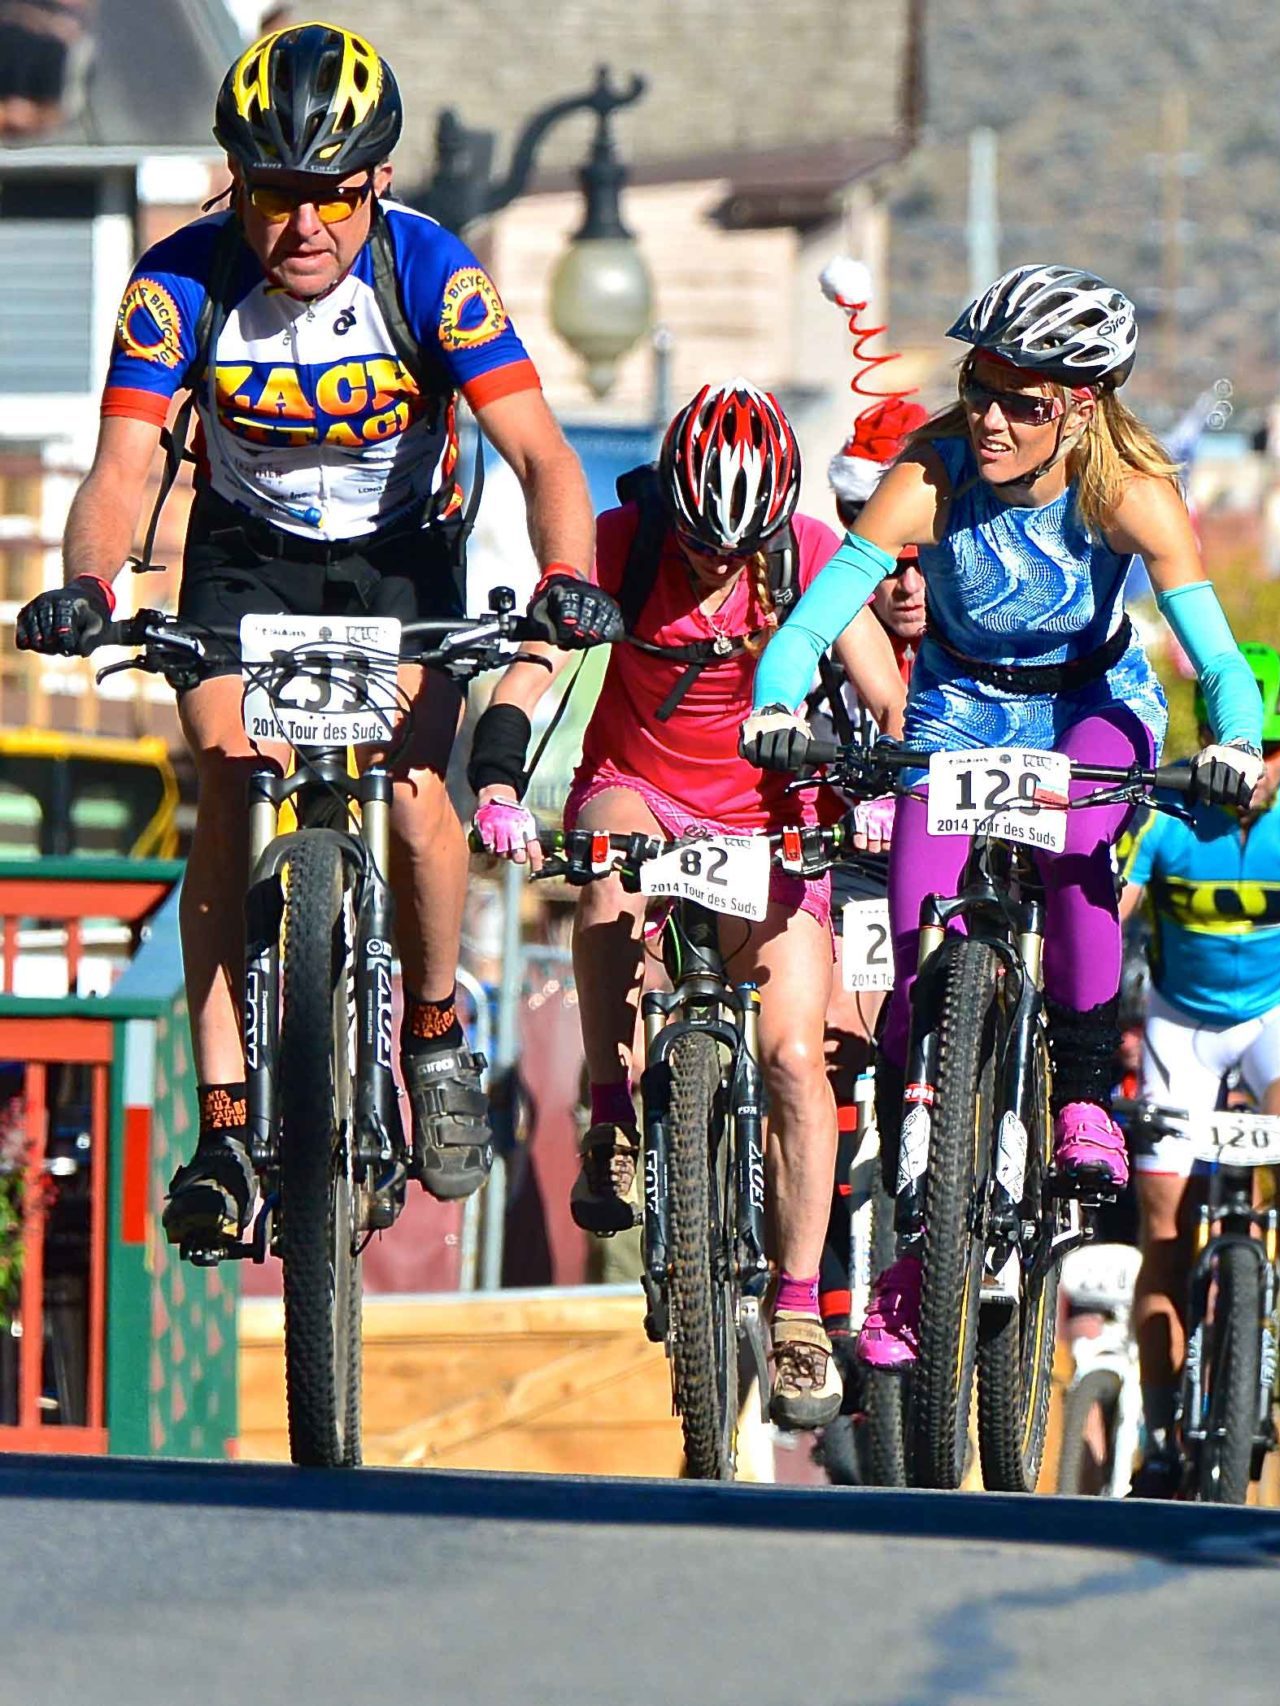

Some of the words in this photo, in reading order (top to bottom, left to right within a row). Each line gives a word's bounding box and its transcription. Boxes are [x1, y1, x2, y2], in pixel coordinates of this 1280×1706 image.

[1097, 315, 1127, 337] Giro
[253, 717, 285, 738] 2014
[288, 720, 319, 740] Tour
[323, 721, 348, 741] des
[351, 721, 384, 741] Suds
[937, 818, 969, 832] 2014
[972, 818, 1000, 833] Tour
[1003, 825, 1025, 839] des
[1028, 827, 1057, 848] Suds
[680, 846, 729, 887] 82
[650, 882, 680, 893] 2014
[683, 882, 706, 900] Tour
[707, 892, 728, 908] des
[730, 897, 758, 916] Suds
[866, 923, 888, 965] 2
[851, 973, 878, 987] 2014
[1210, 1126, 1270, 1149] 120
